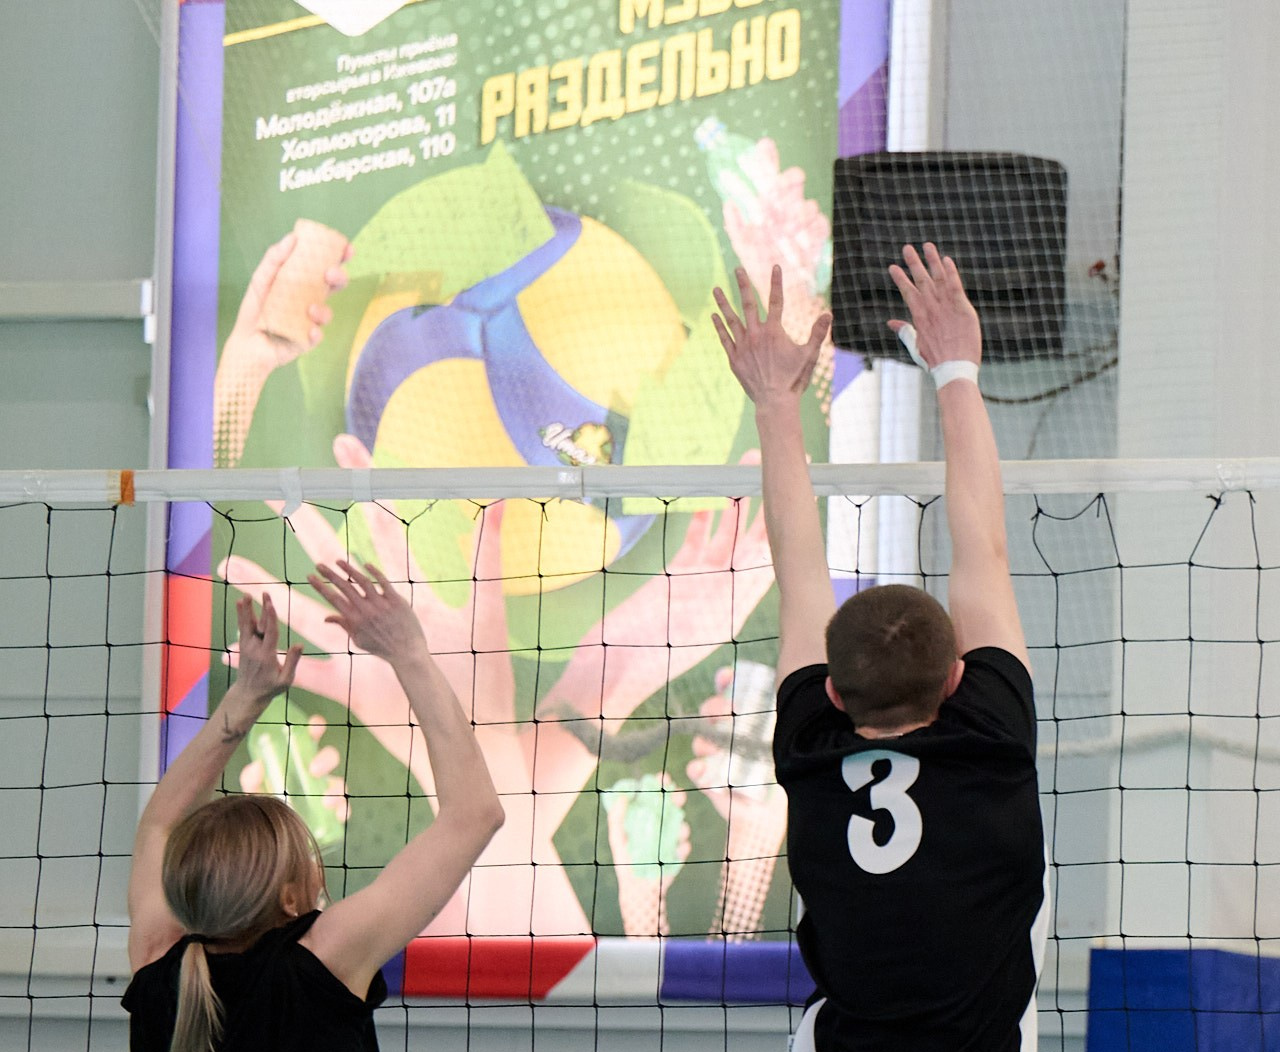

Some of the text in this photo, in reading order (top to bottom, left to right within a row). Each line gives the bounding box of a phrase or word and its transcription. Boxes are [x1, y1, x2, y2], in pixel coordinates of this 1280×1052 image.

[256, 75, 457, 140] Молодёжная, 107а
[481, 8, 801, 146] РАЗДЕЛЬНО
[281, 101, 457, 163] Холмогорова, 11
[419, 131, 457, 160] 110
[842, 749, 923, 875] 3
